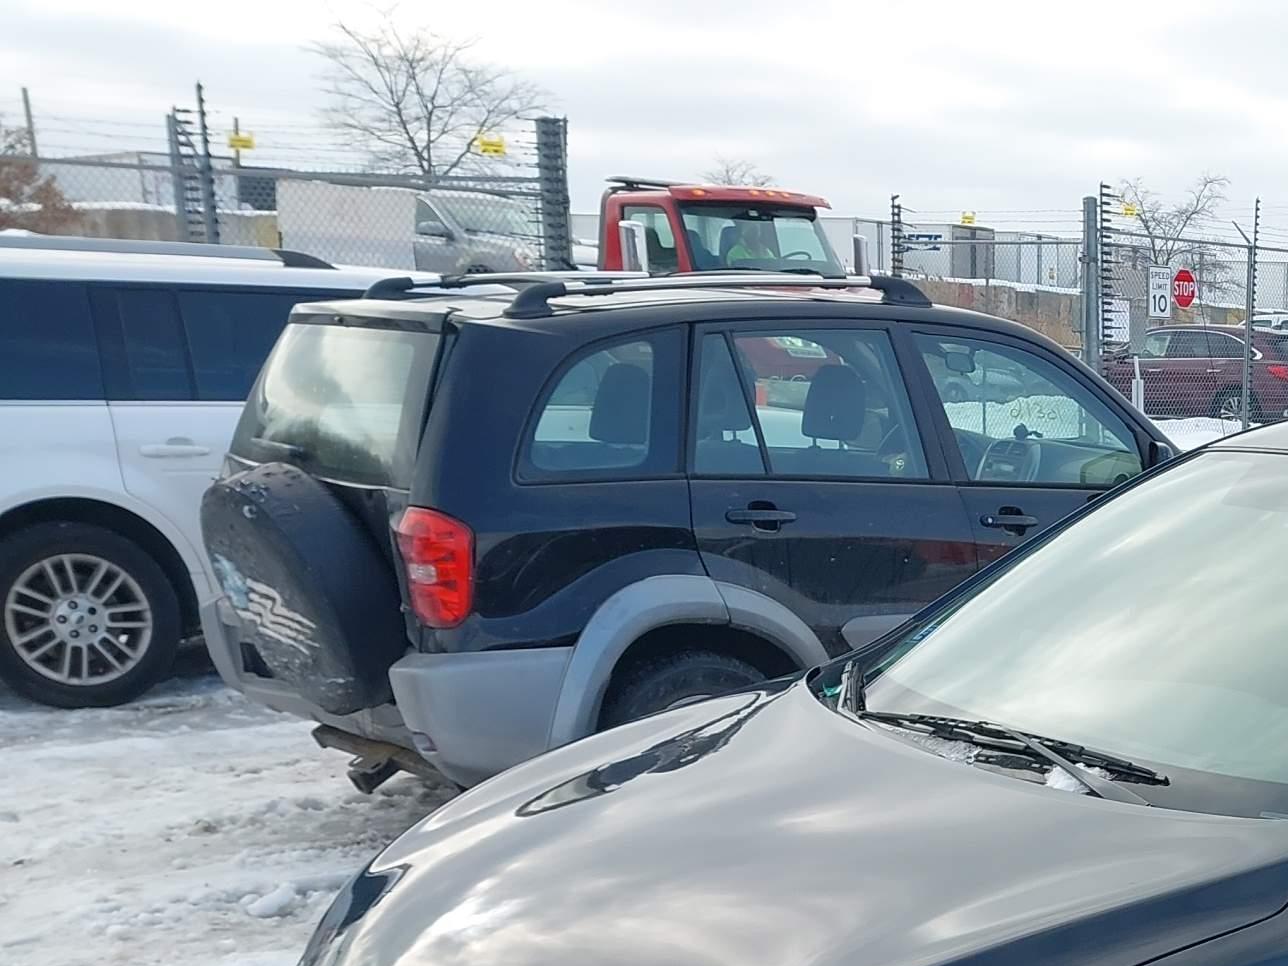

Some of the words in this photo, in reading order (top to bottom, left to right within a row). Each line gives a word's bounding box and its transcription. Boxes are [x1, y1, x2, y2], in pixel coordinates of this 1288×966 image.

[1152, 272, 1170, 281] SPEED
[1152, 283, 1168, 292] LIMIT
[1174, 281, 1195, 296] STOP
[1153, 294, 1168, 313] 10
